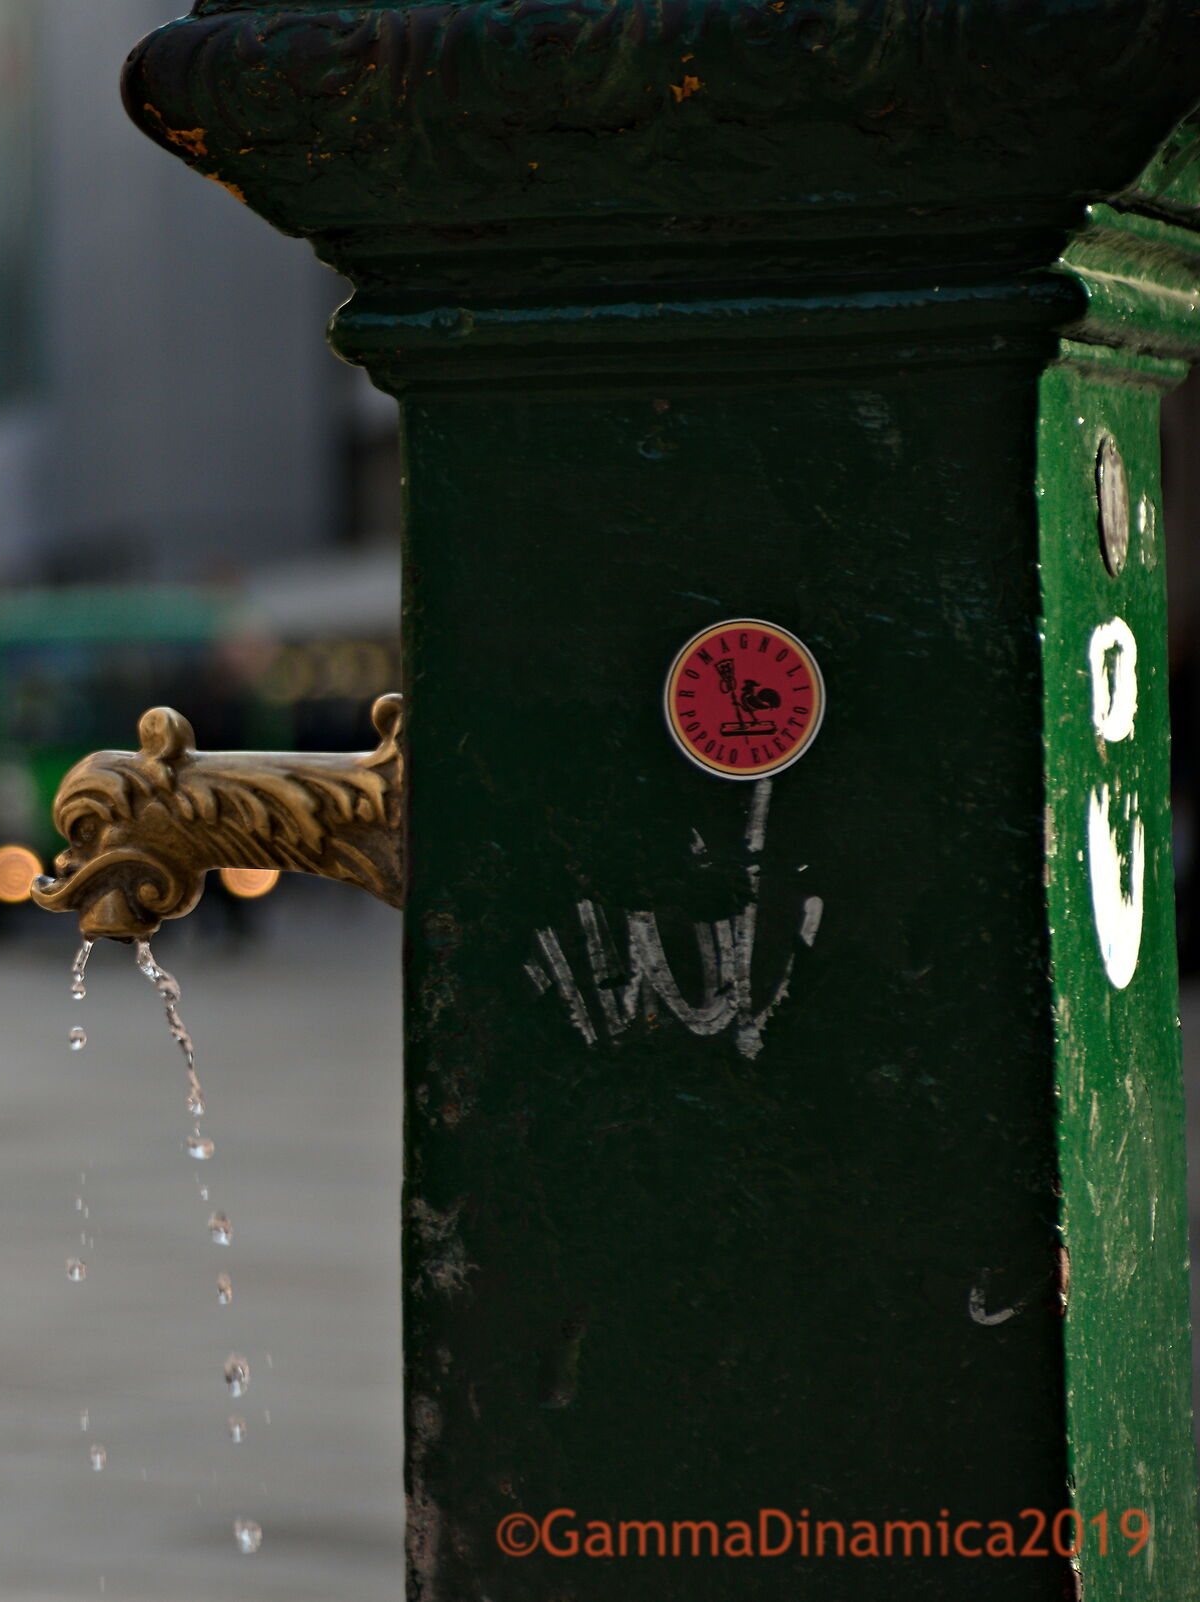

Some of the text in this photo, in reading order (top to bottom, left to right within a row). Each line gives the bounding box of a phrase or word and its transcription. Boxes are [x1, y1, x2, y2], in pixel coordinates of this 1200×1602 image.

[678, 633, 810, 698] ROMAGNOLI
[680, 706, 809, 764] POPOLO ELETTO
